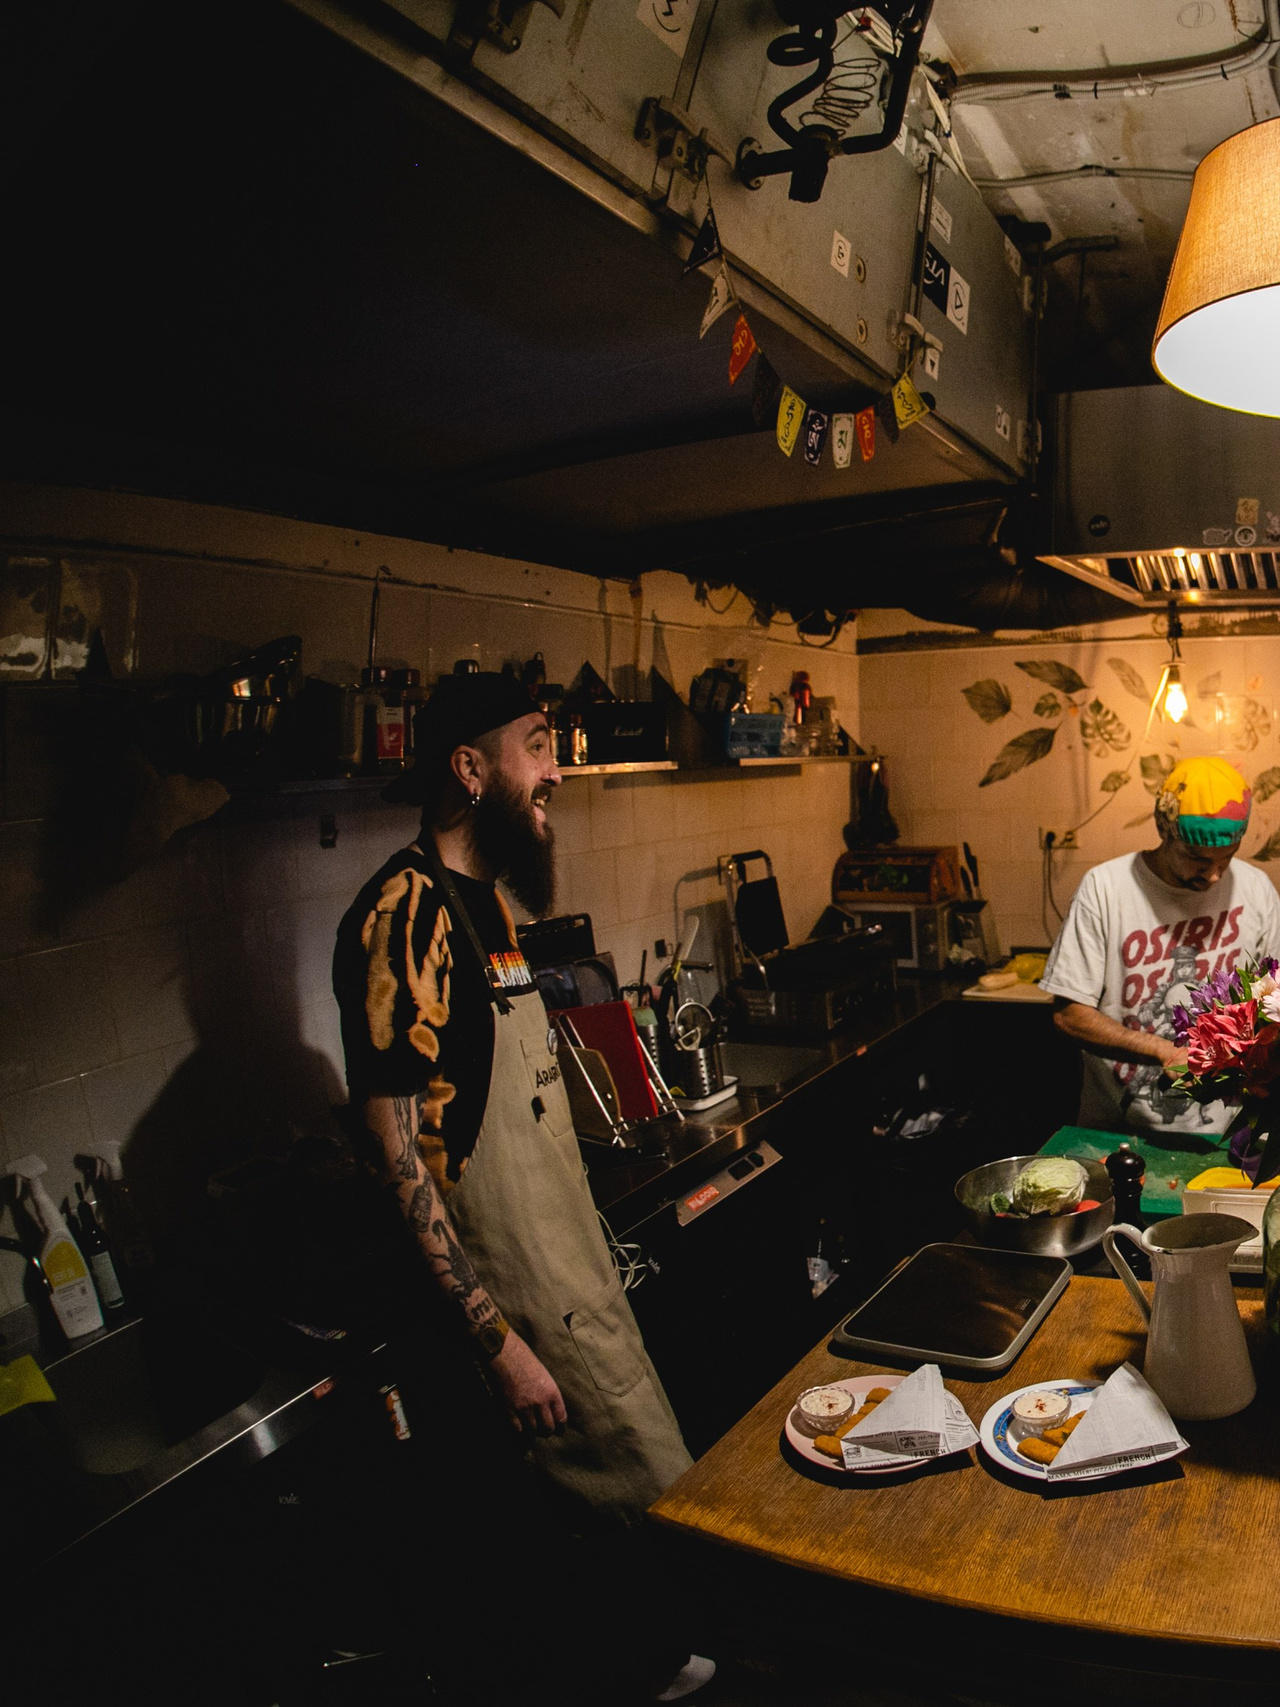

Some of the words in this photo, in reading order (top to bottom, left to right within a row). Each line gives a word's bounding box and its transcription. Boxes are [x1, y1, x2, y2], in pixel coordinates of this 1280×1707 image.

[1121, 905, 1243, 969] OSIRIS
[914, 1448, 946, 1459] FRENCH
[1117, 1453, 1151, 1464] FRENCH
